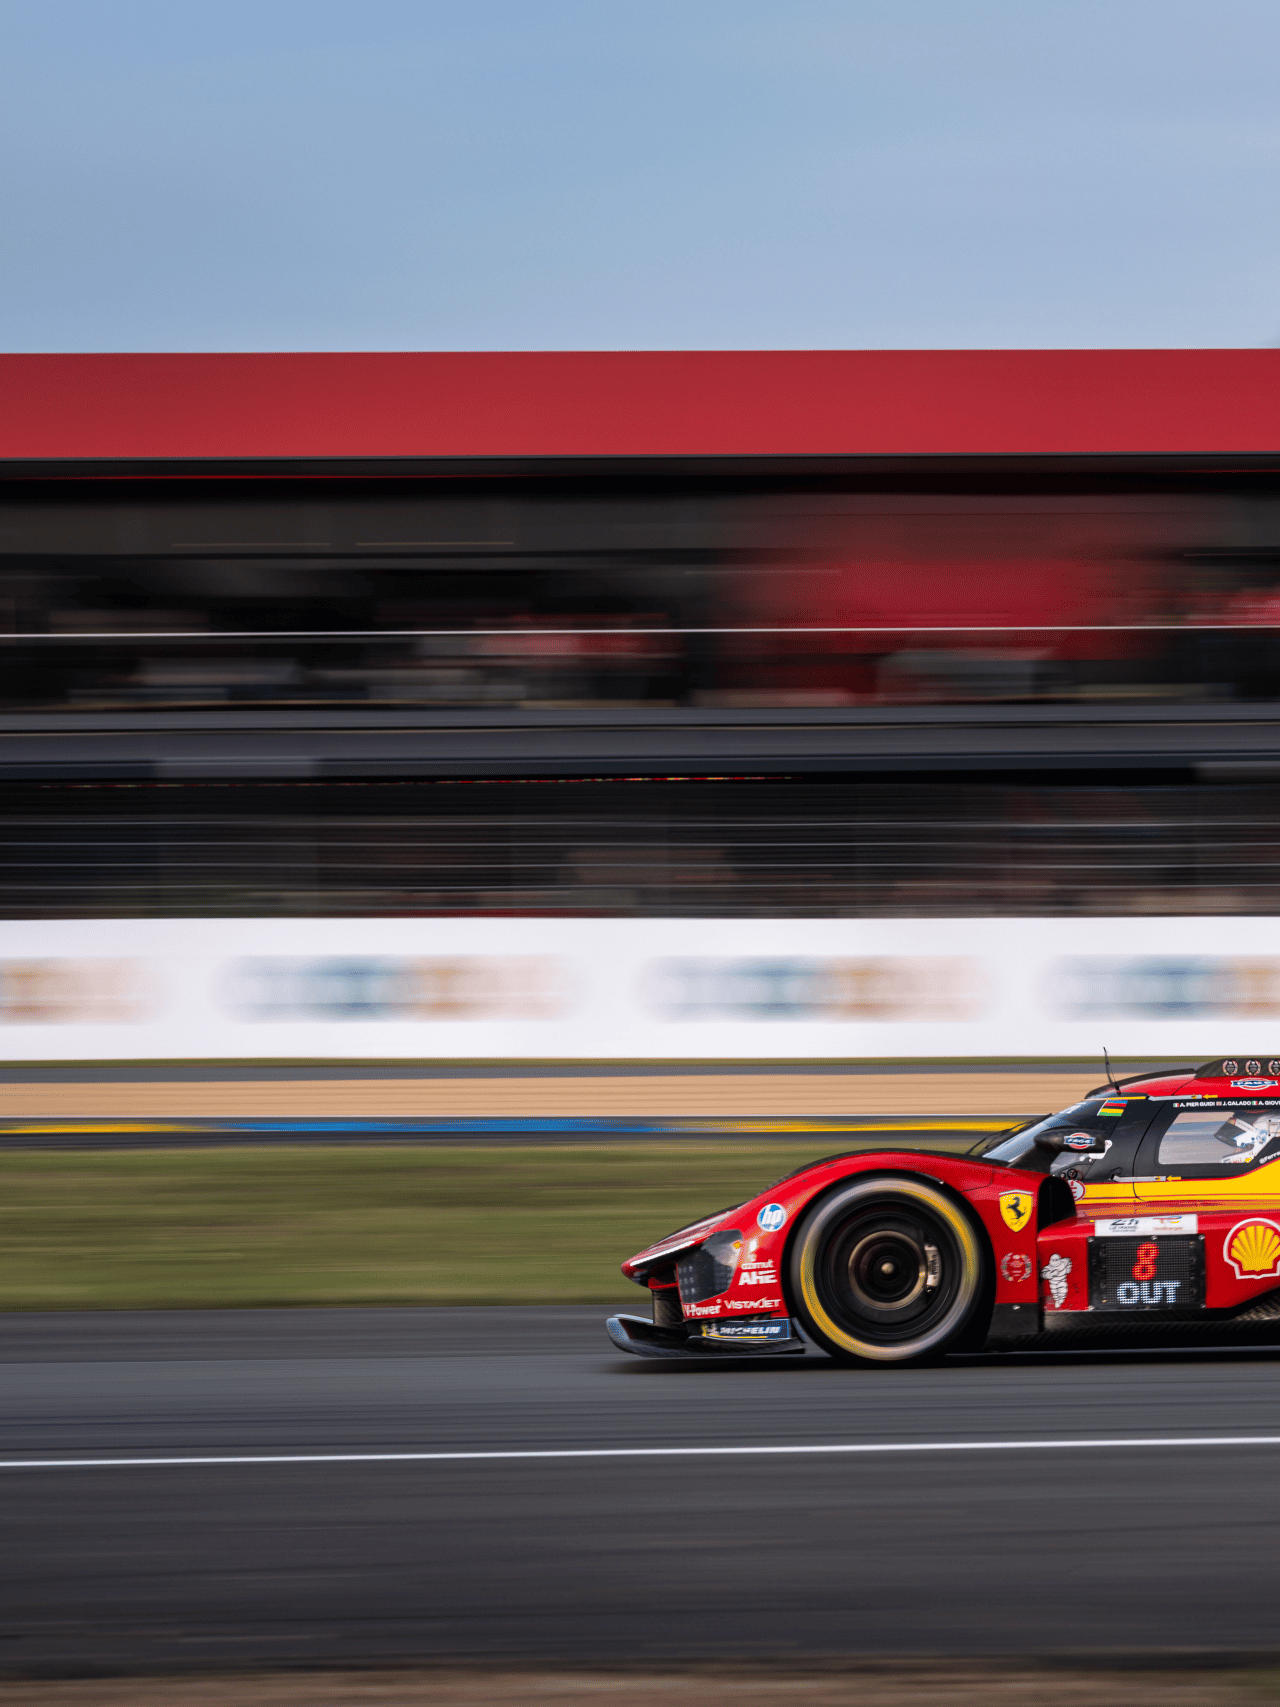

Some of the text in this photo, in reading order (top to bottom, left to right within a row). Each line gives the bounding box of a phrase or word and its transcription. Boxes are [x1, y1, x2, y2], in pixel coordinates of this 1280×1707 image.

[760, 1205, 784, 1231] hp
[1132, 1242, 1159, 1281] 8
[1117, 1281, 1181, 1304] OUT
[720, 1326, 781, 1335] MICHELIN
